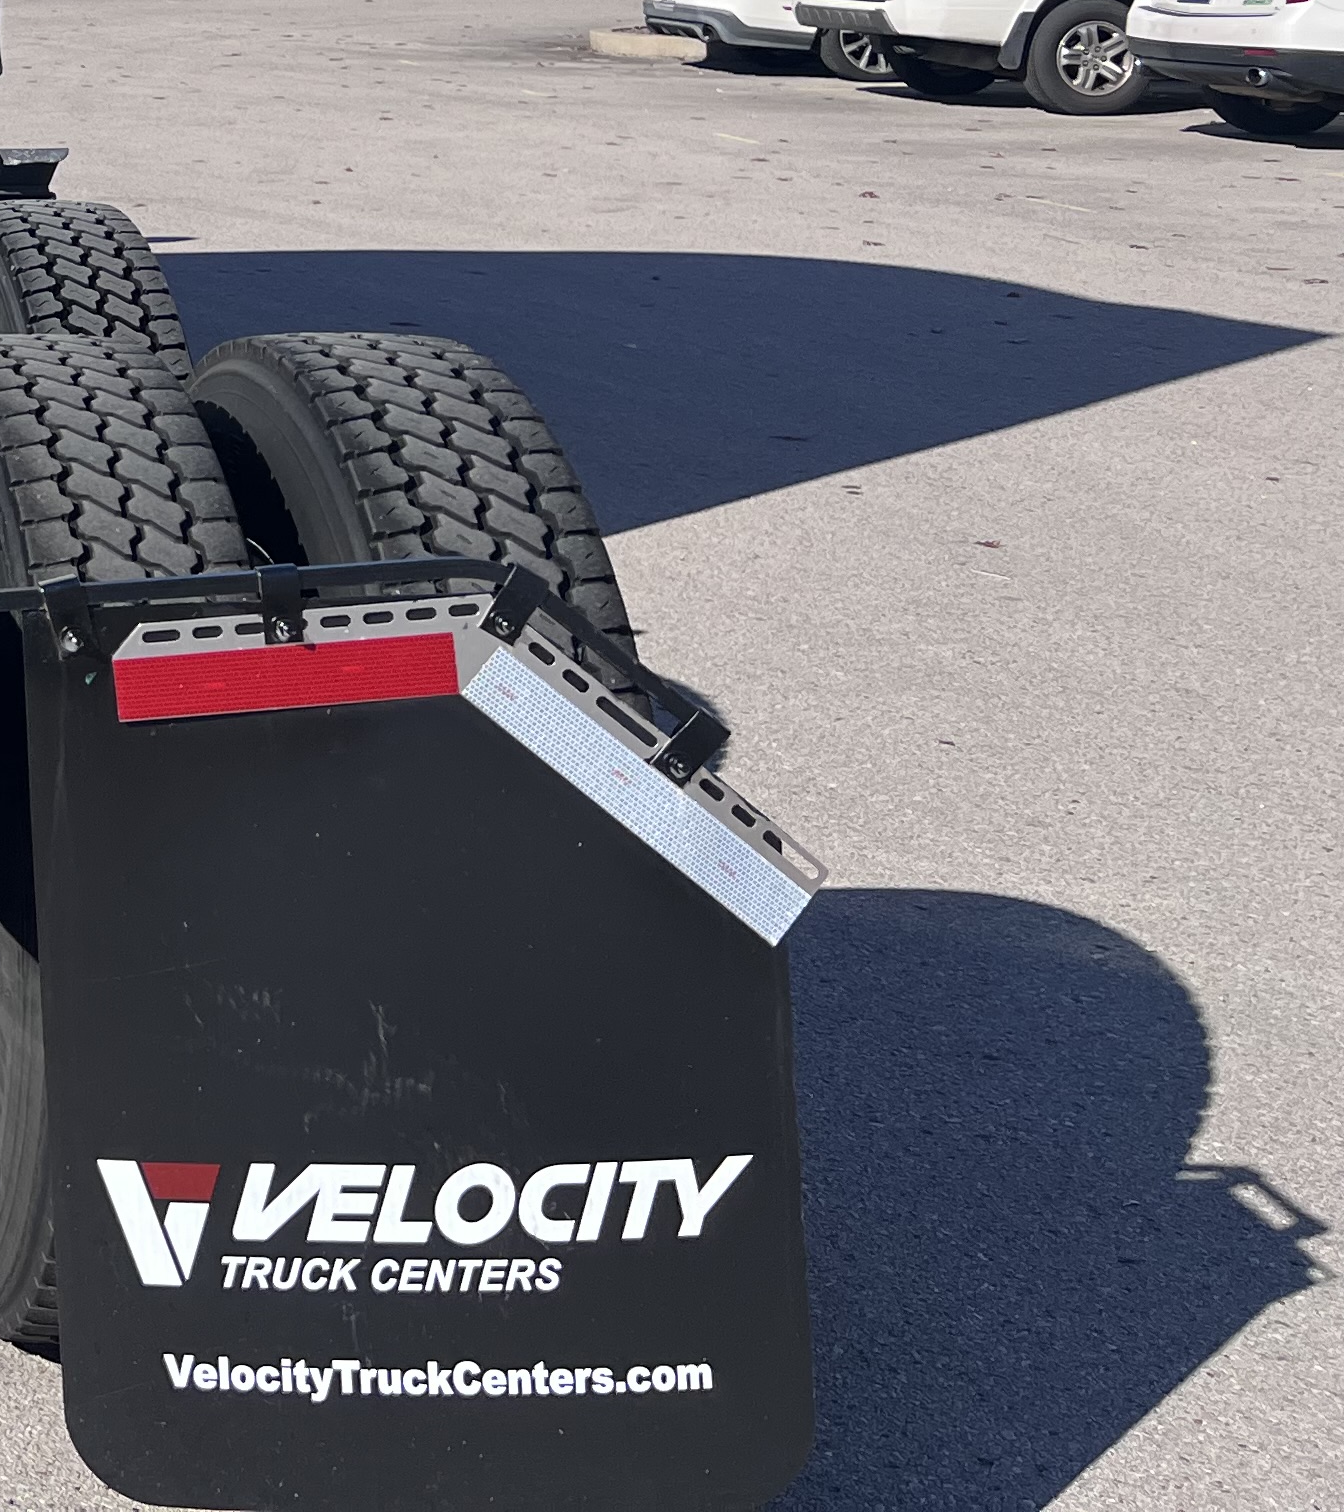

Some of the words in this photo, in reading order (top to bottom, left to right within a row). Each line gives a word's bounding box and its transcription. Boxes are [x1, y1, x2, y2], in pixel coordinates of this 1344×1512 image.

[232, 1154, 754, 1245] VELOCITY
[221, 1255, 362, 1291] TRUCK
[371, 1257, 563, 1292] CENTERS
[163, 1353, 713, 1403] VelocityTruckCenters.com
